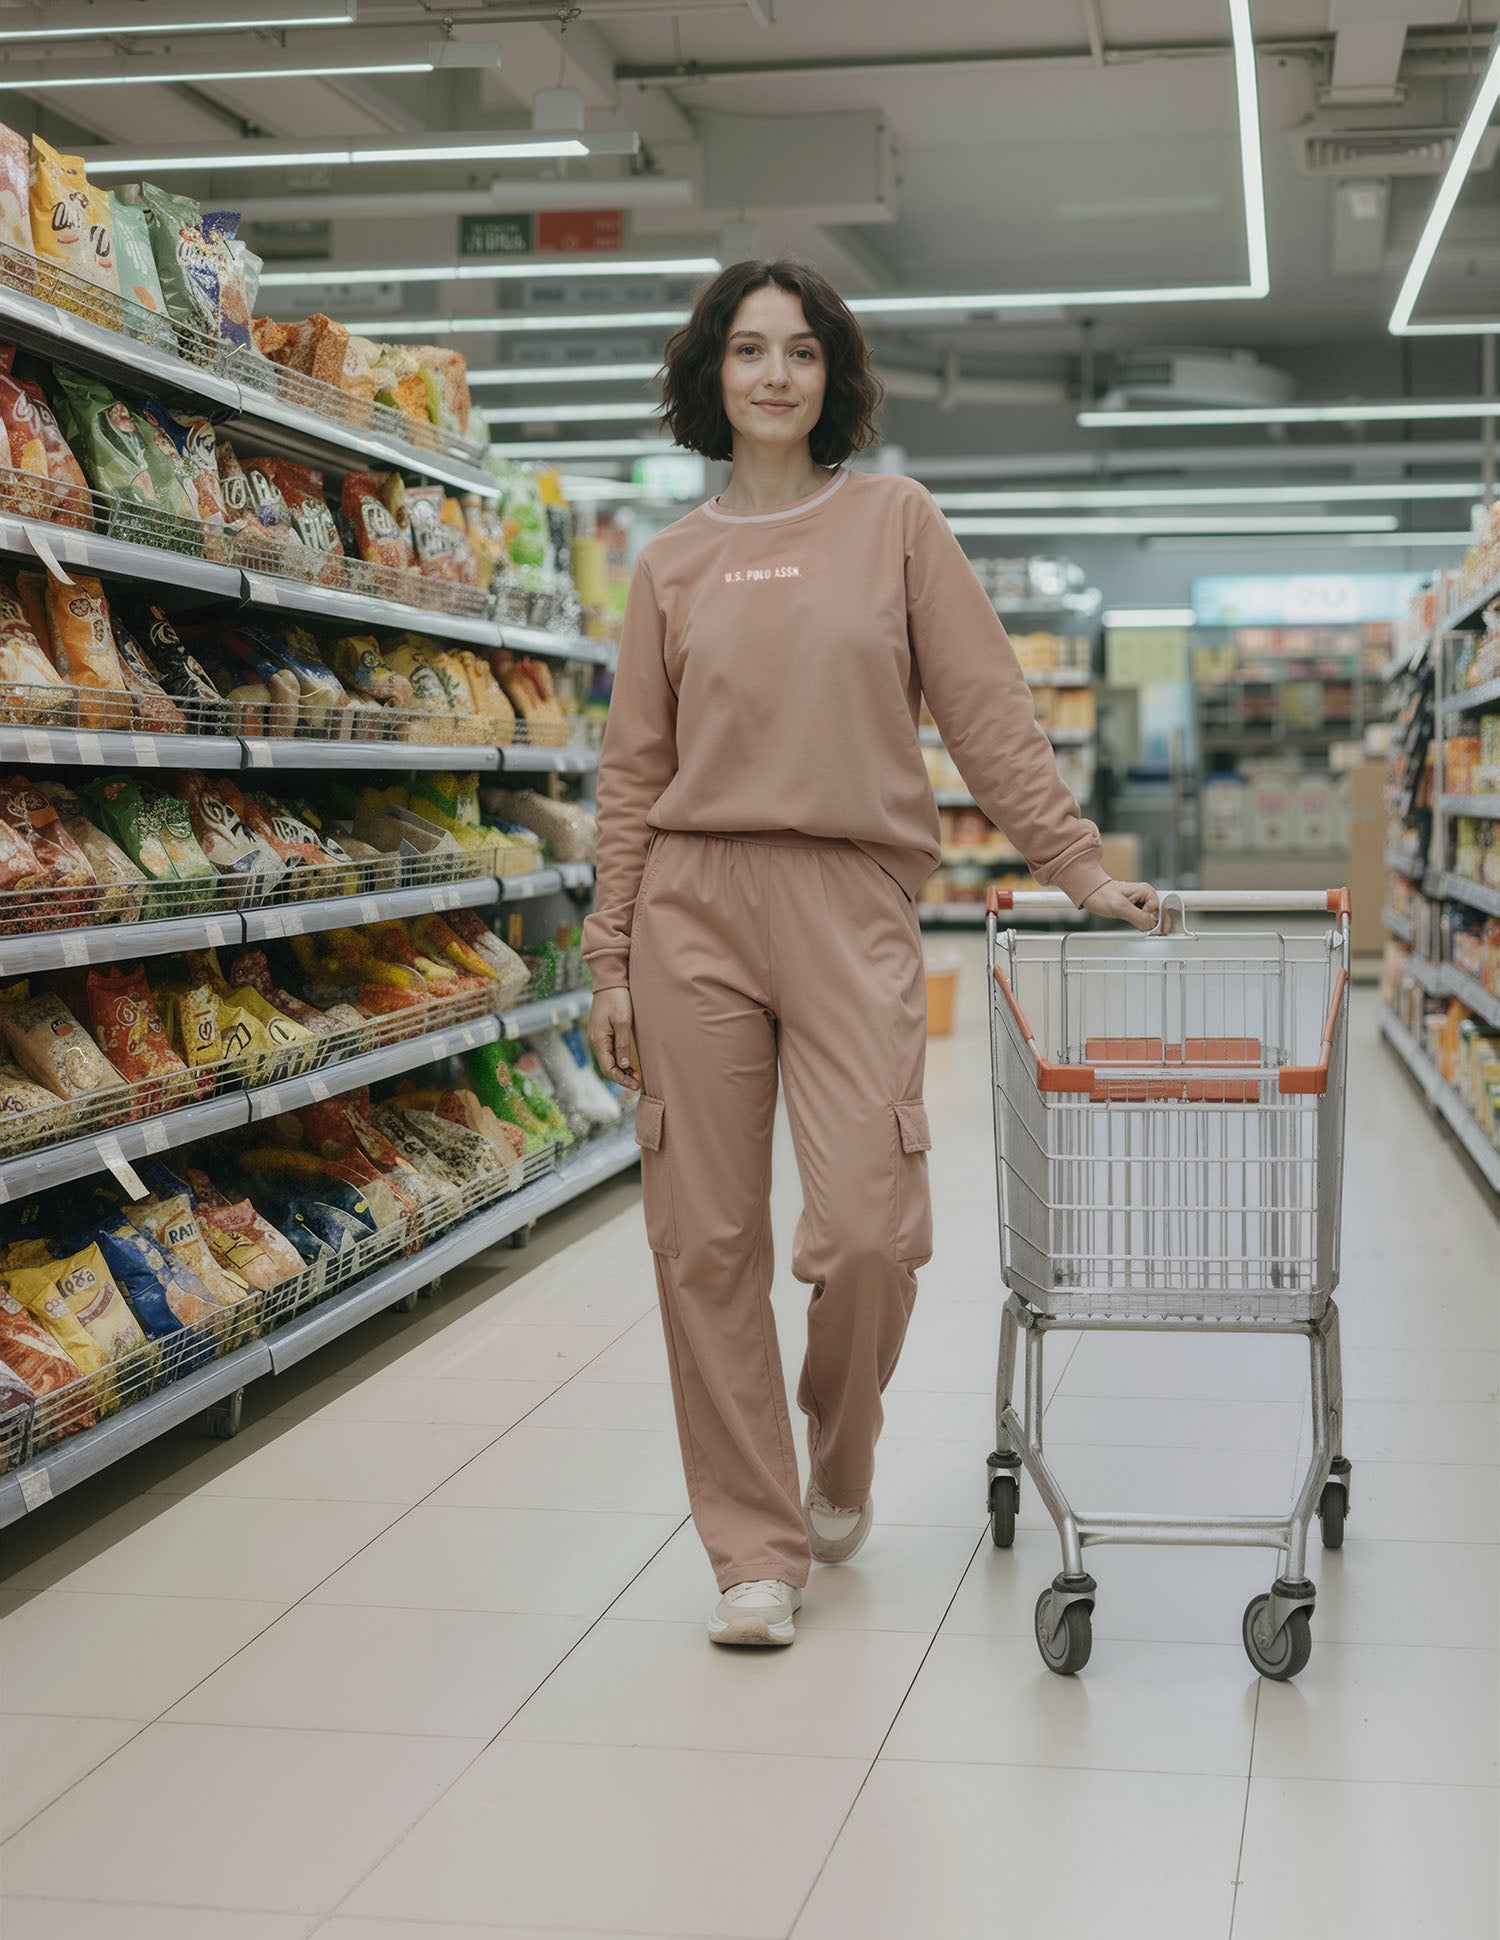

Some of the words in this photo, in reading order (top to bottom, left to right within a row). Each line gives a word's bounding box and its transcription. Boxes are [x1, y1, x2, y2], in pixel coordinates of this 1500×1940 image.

[724, 571, 744, 583] U.S.
[746, 569, 772, 581] POLO
[774, 566, 802, 578] ASSN.
